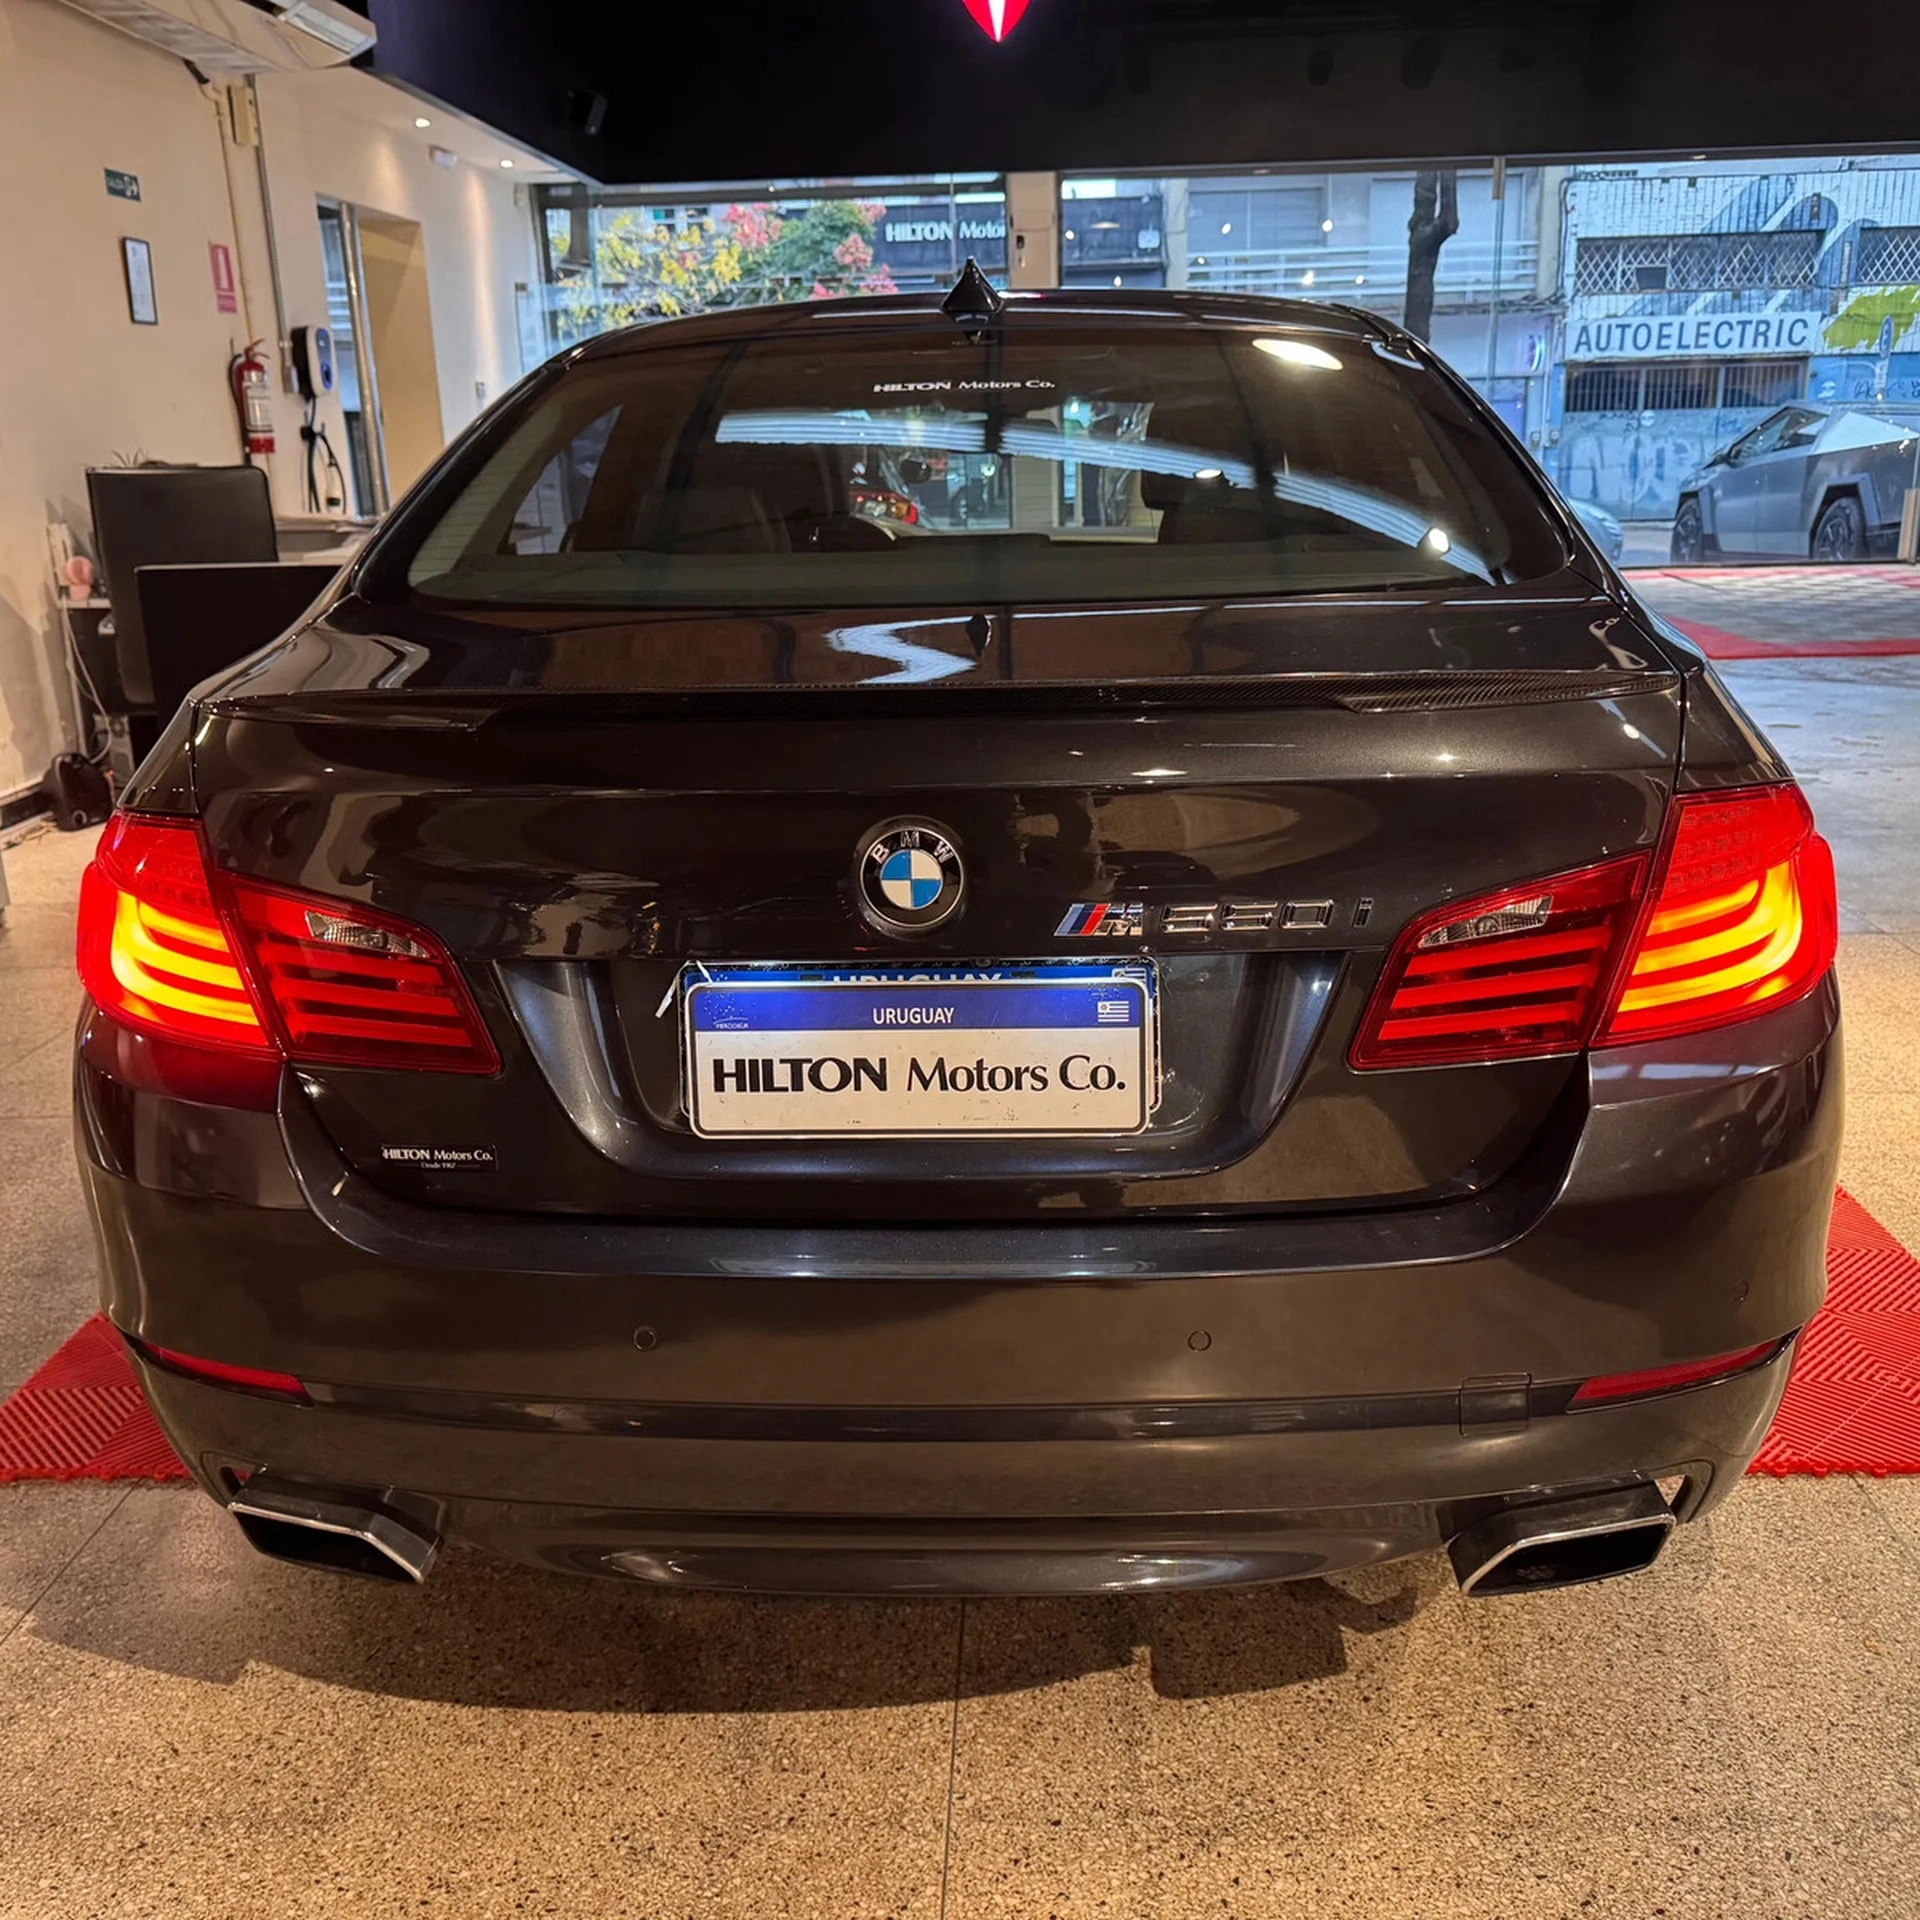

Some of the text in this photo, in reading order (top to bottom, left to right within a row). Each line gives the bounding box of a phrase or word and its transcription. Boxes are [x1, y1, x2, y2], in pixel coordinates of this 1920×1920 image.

[885, 222, 953, 242] HILTON
[1574, 318, 1809, 353] AUTOELECTRIC
[873, 379, 1056, 393] HILTON Motors Co.
[870, 830, 954, 864] BMW
[872, 1007, 955, 1025] URUGUAY
[712, 1054, 1127, 1093] HILTON Motors Co.
[383, 1148, 494, 1161] HILTON Motors Co.
